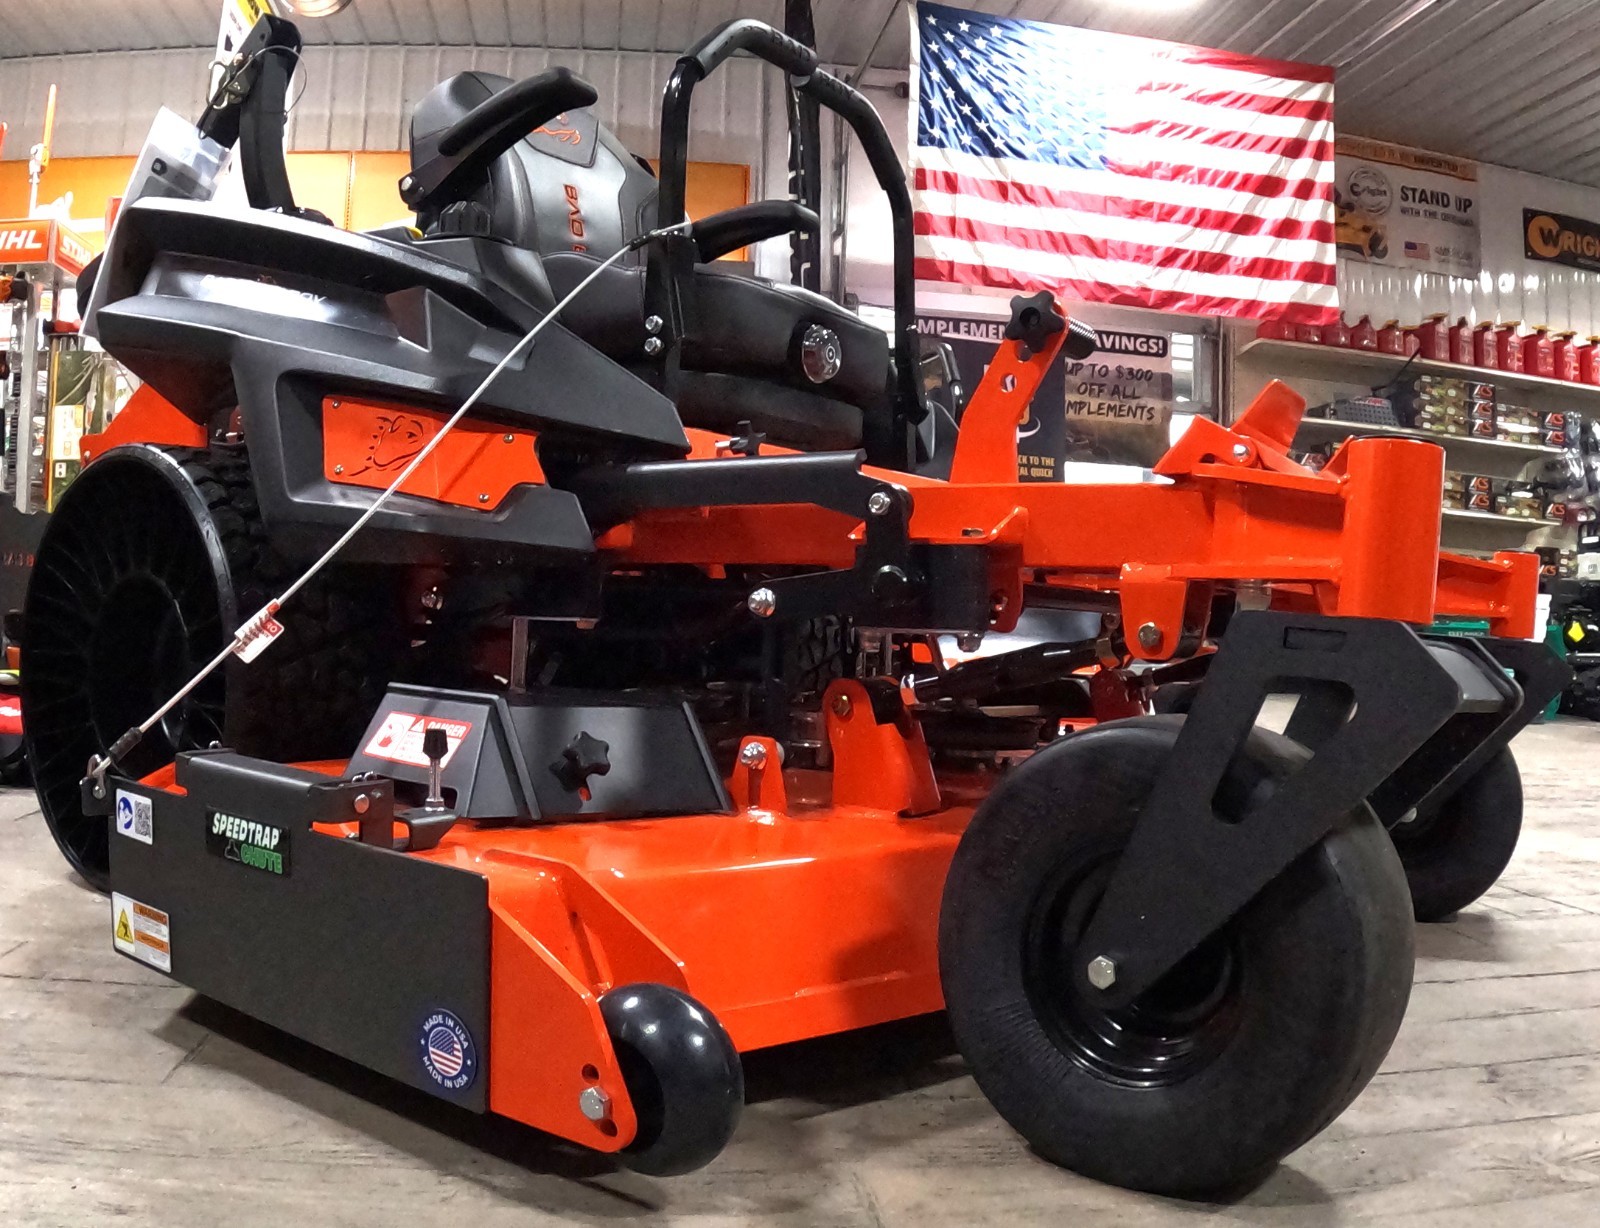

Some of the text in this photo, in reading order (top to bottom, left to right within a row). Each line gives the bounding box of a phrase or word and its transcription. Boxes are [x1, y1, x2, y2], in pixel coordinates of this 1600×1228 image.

[563, 184, 584, 237] BAD
[1400, 185, 1473, 213] STAND UP
[1400, 205, 1420, 217] WITH
[1066, 361, 1153, 381] UP TO $300
[1077, 382, 1141, 400] OFF ALL
[1066, 400, 1155, 420] MPLEMENTS
[1029, 456, 1040, 465] TO
[1041, 457, 1055, 467] THE
[1031, 467, 1054, 478] QUICK
[212, 812, 280, 850] SPEEDTRAP
[241, 843, 283, 875] CHUTE
[423, 1015, 469, 1049] MADE IN USA
[422, 1056, 469, 1088] MADE IN USA
